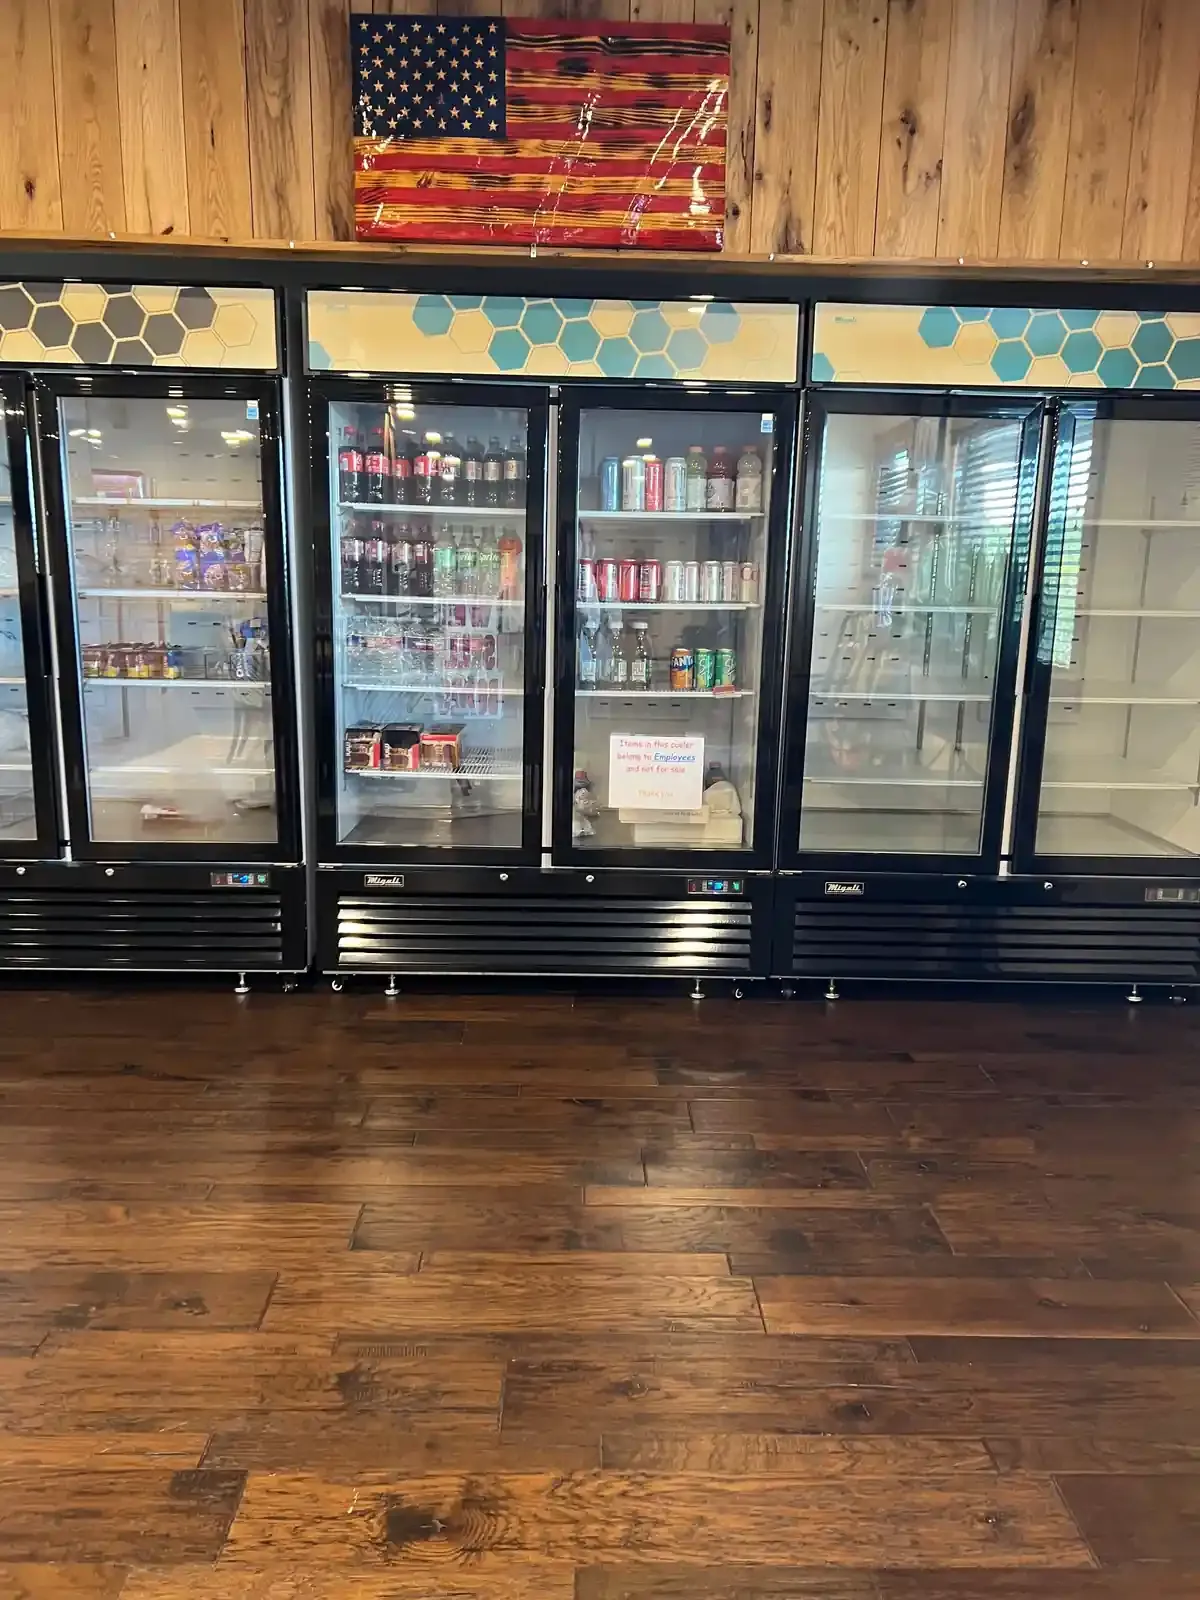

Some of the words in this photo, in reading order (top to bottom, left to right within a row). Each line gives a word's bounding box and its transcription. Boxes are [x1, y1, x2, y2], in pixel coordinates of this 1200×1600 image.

[620, 739, 641, 748] Items
[644, 740, 652, 749] in
[654, 740, 669, 749] this
[670, 740, 694, 749] cooler
[643, 753, 652, 761] to
[653, 752, 696, 763] Employees
[626, 765, 640, 773] and
[641, 765, 654, 773] not
[656, 765, 668, 773] for
[670, 766, 685, 774] sale
